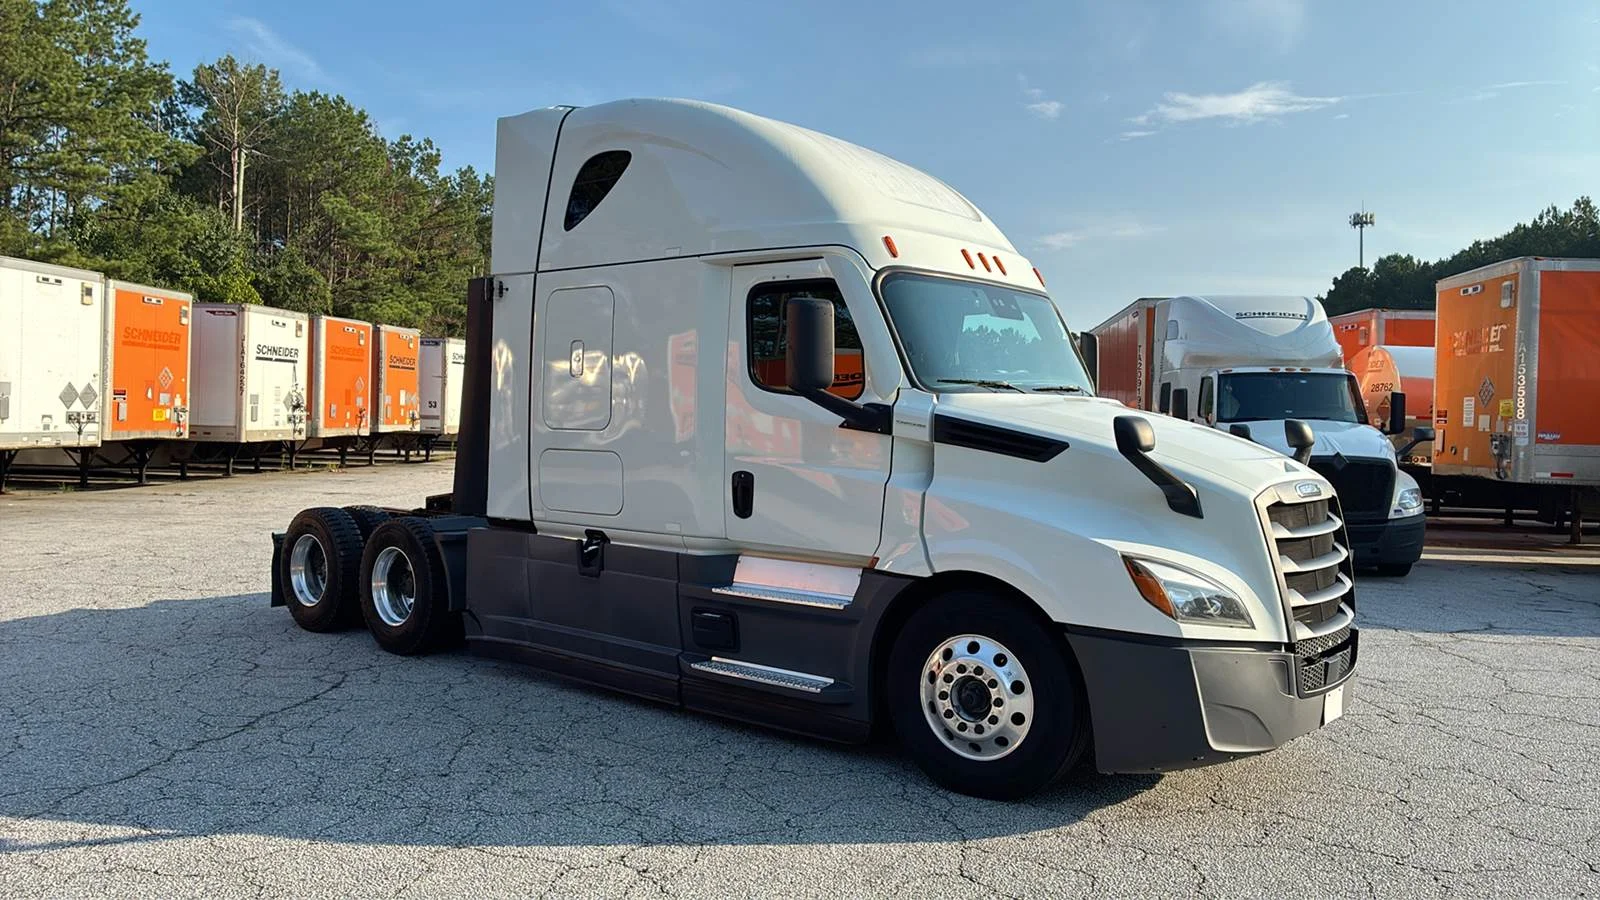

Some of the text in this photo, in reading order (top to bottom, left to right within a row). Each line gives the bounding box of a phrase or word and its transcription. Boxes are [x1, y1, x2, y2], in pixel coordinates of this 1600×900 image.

[123, 326, 181, 344] SCHNEIDER
[256, 344, 299, 358] SCHNEIDER
[389, 354, 416, 366] SCHNEIDER
[1517, 329, 1527, 419] TA153588
[1371, 382, 1393, 393] 28762
[428, 400, 437, 408] 53
